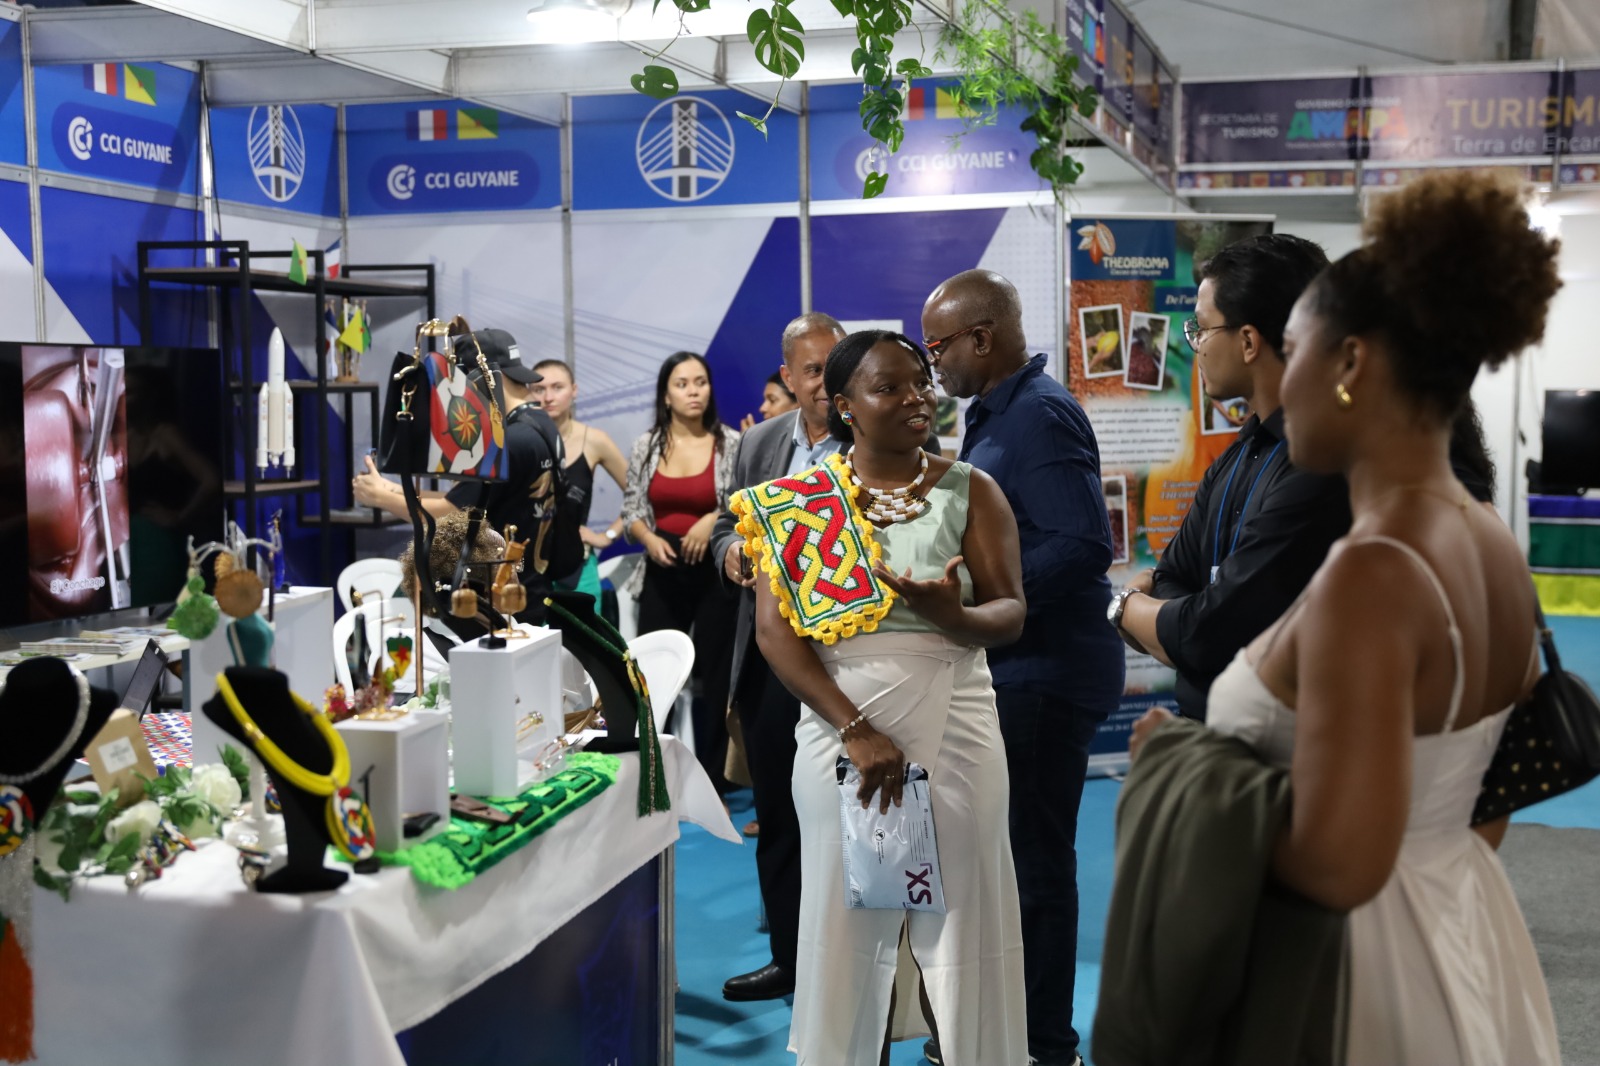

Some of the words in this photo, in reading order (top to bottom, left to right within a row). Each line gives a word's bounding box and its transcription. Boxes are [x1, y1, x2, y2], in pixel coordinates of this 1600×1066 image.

[1446, 95, 1600, 129] TURISM
[1221, 127, 1279, 139] TURISMO
[1453, 134, 1506, 153] Terra
[1511, 133, 1537, 152] de
[100, 132, 121, 152] CCI
[124, 137, 172, 165] GUYANE
[899, 154, 927, 172] CCI
[931, 151, 1004, 171] GUYANE
[424, 172, 451, 189] CCI
[454, 169, 519, 188] GUYANE
[1102, 256, 1169, 269] THEOBROMA
[1165, 294, 1178, 305] De
[905, 867, 932, 905] XS
